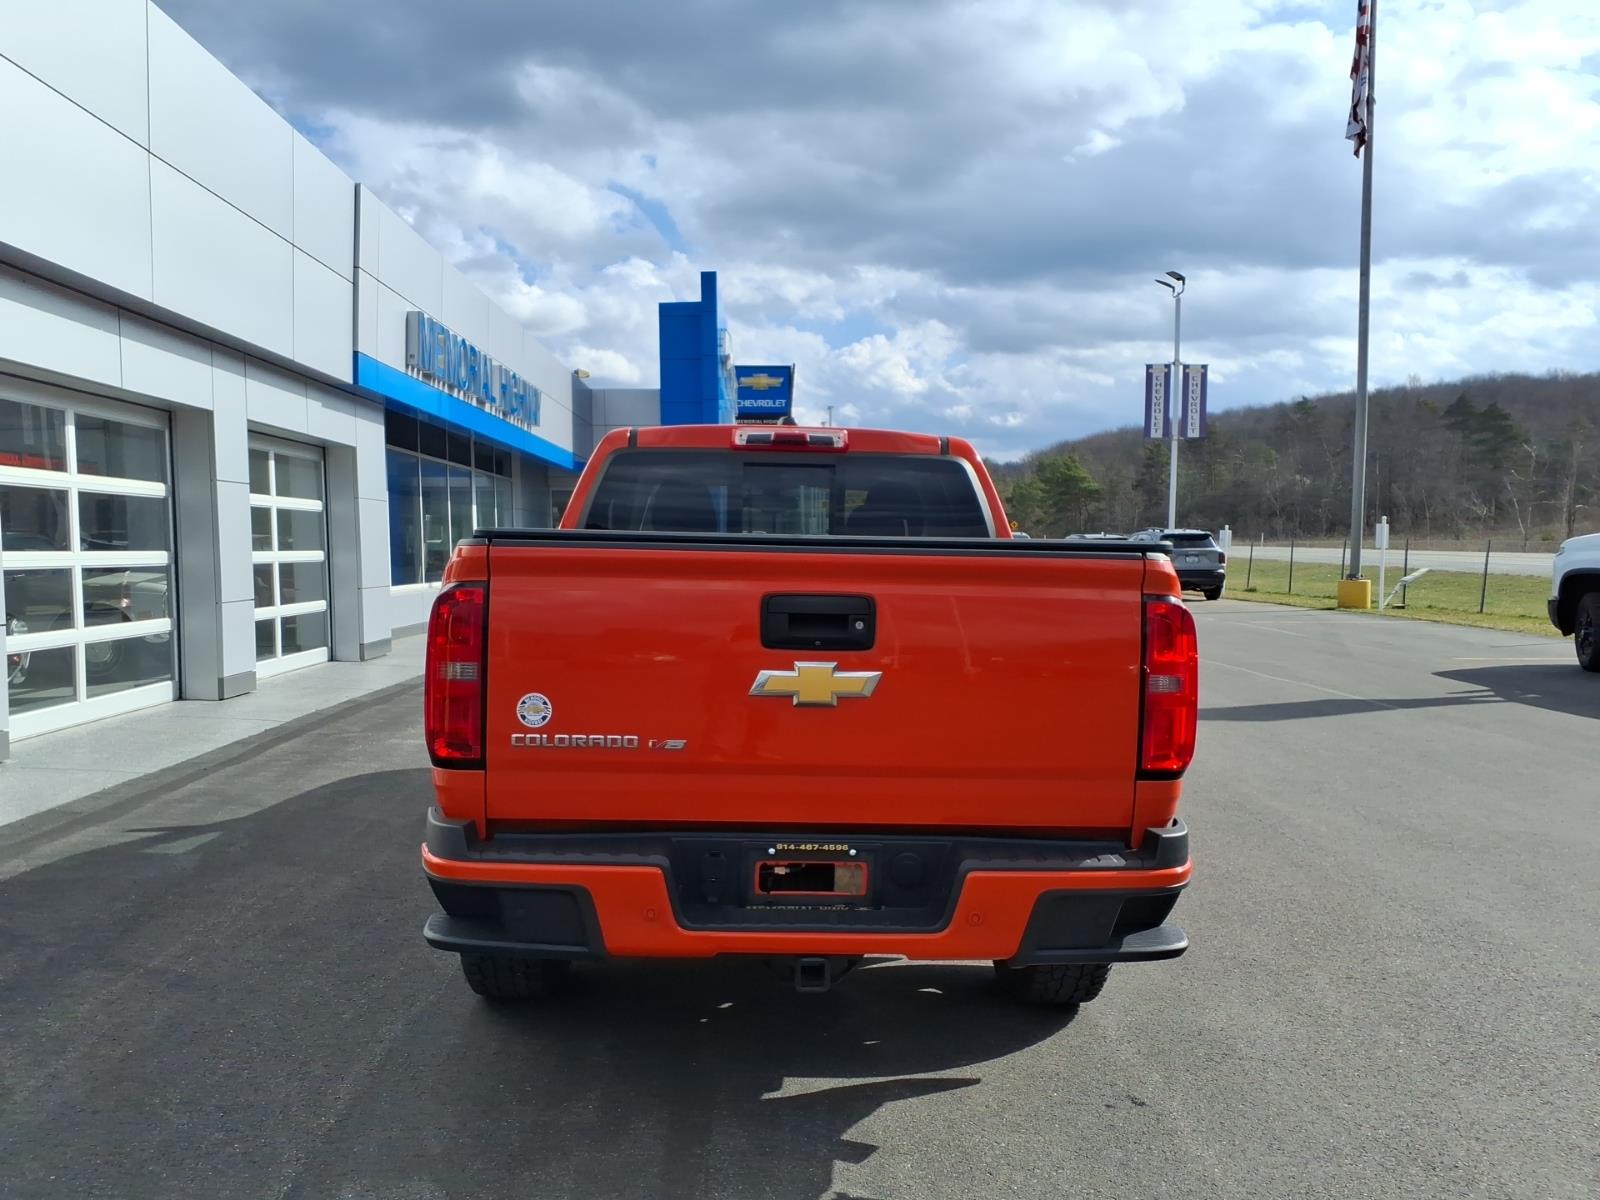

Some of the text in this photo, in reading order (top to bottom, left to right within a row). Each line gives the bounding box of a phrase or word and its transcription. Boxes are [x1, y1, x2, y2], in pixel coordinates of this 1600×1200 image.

[737, 399, 786, 408] CHEVROLET
[1154, 376, 1162, 434] CHEVROLET
[1191, 376, 1199, 434] CHEVROLET
[511, 733, 639, 748] COLORADO
